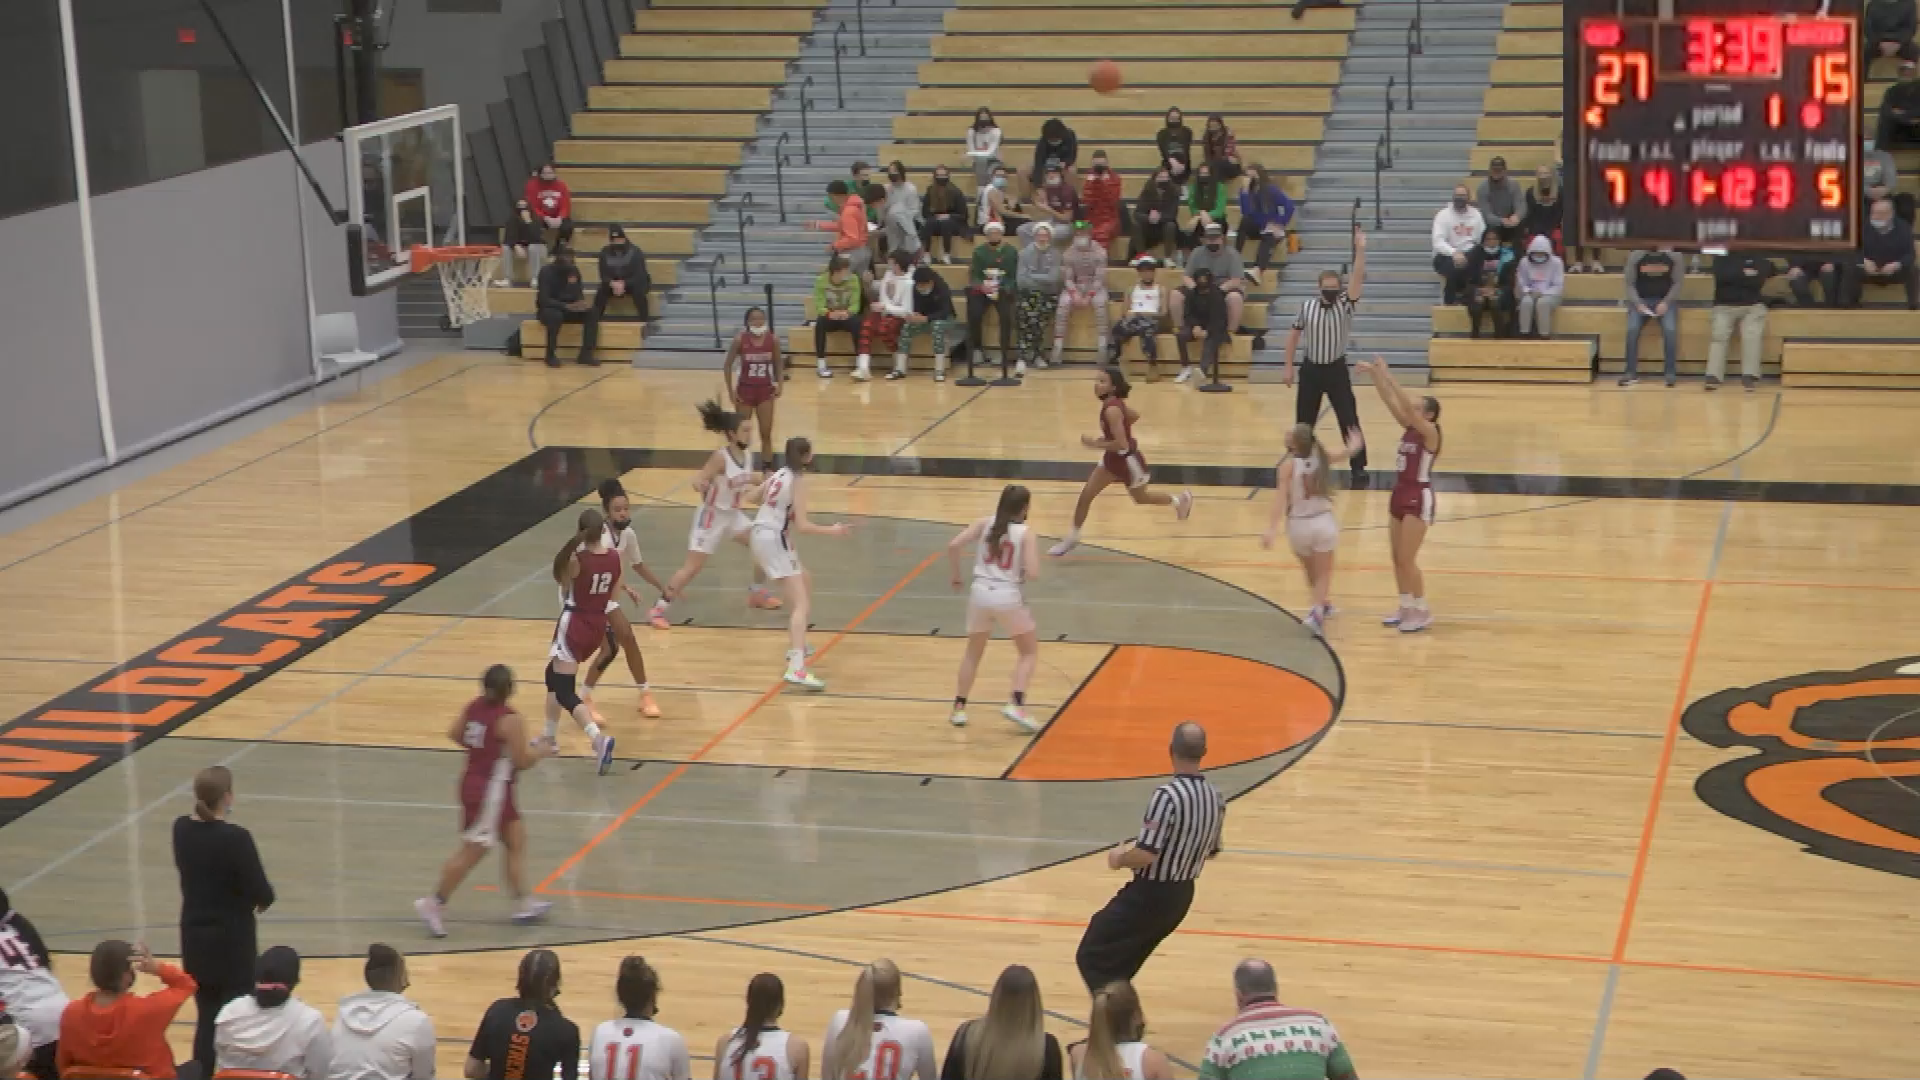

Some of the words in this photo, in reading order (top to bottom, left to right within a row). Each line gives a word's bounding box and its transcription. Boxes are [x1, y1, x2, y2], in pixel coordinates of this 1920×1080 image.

[1687, 19, 1782, 75] 3:39
[1593, 52, 1649, 104] 27
[1813, 52, 1849, 104] 15
[1604, 167, 1626, 207] 7
[1644, 167, 1671, 207] 4
[1766, 165, 1793, 209] 3
[1817, 167, 1842, 209] 5
[748, 363, 767, 377] 22
[589, 571, 613, 595] 12
[604, 1042, 644, 1080] 11
